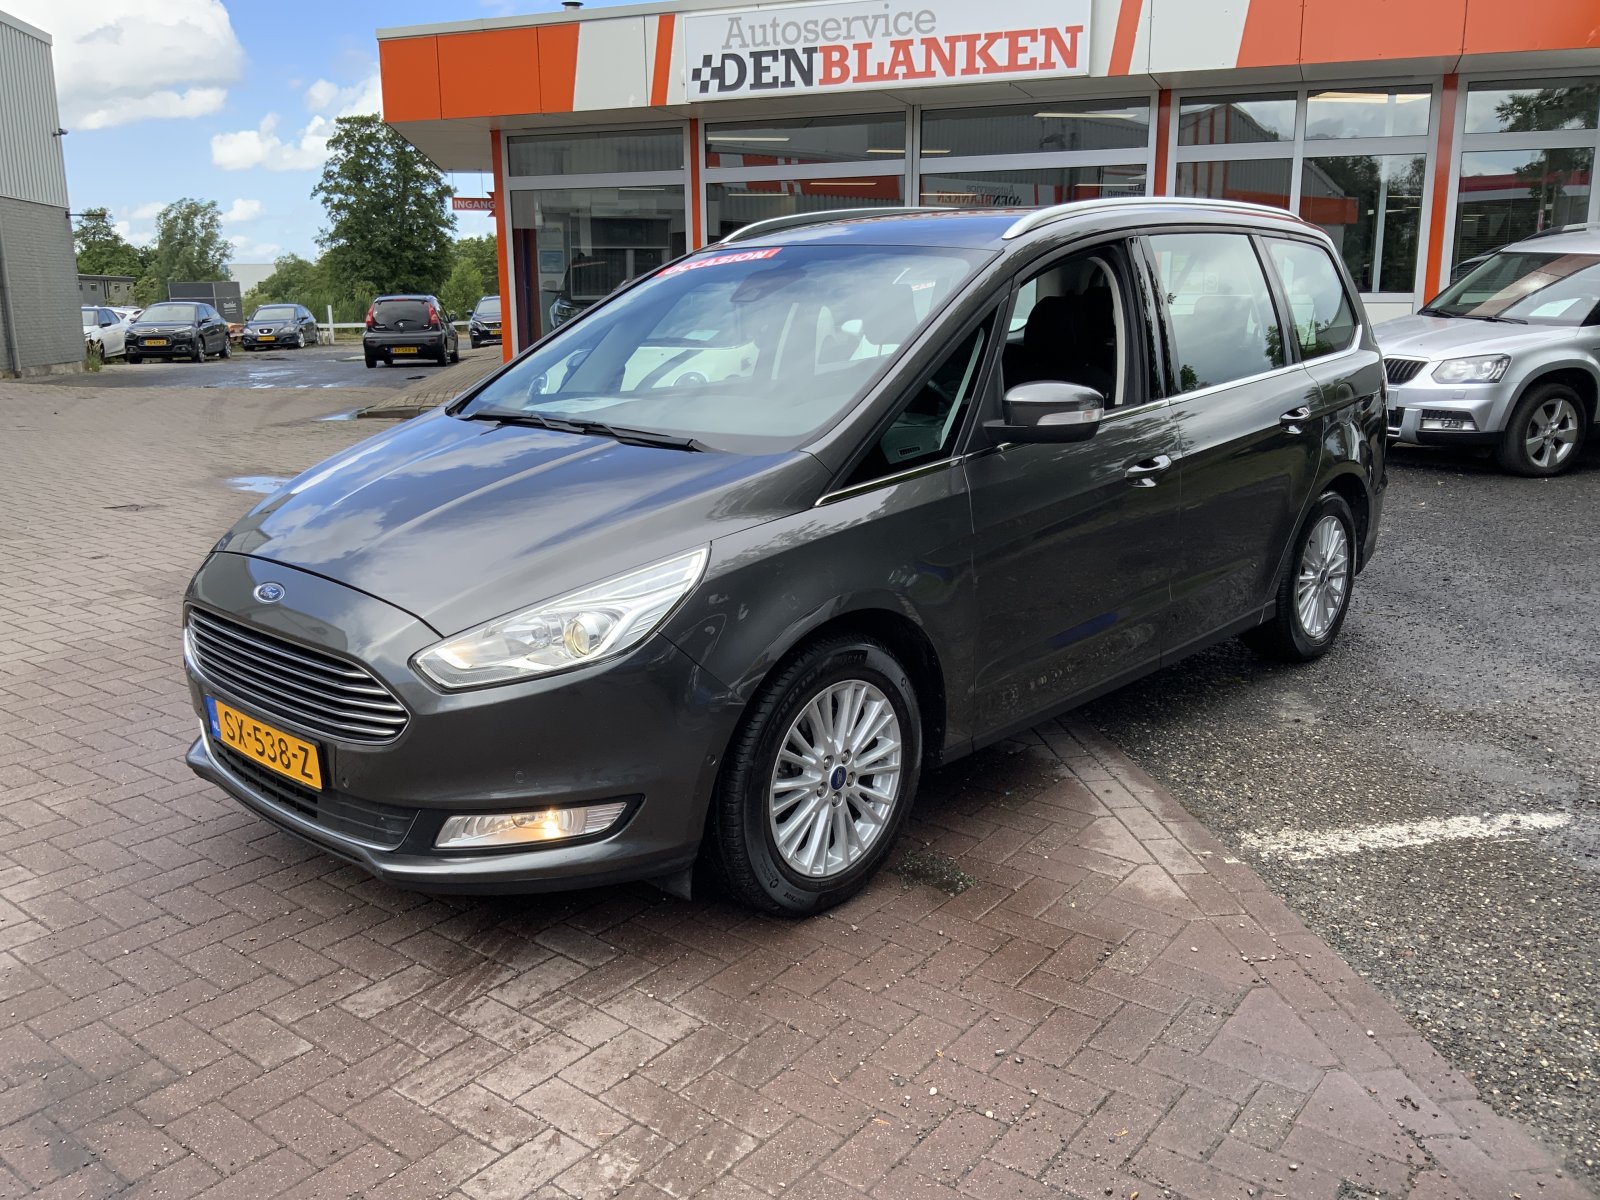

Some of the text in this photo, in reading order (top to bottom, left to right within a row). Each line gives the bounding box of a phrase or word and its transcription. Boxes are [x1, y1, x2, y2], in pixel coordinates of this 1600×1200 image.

[721, 3, 937, 51] Autoservice
[453, 200, 496, 209] INGANG
[224, 710, 314, 780] SX-538-Z
